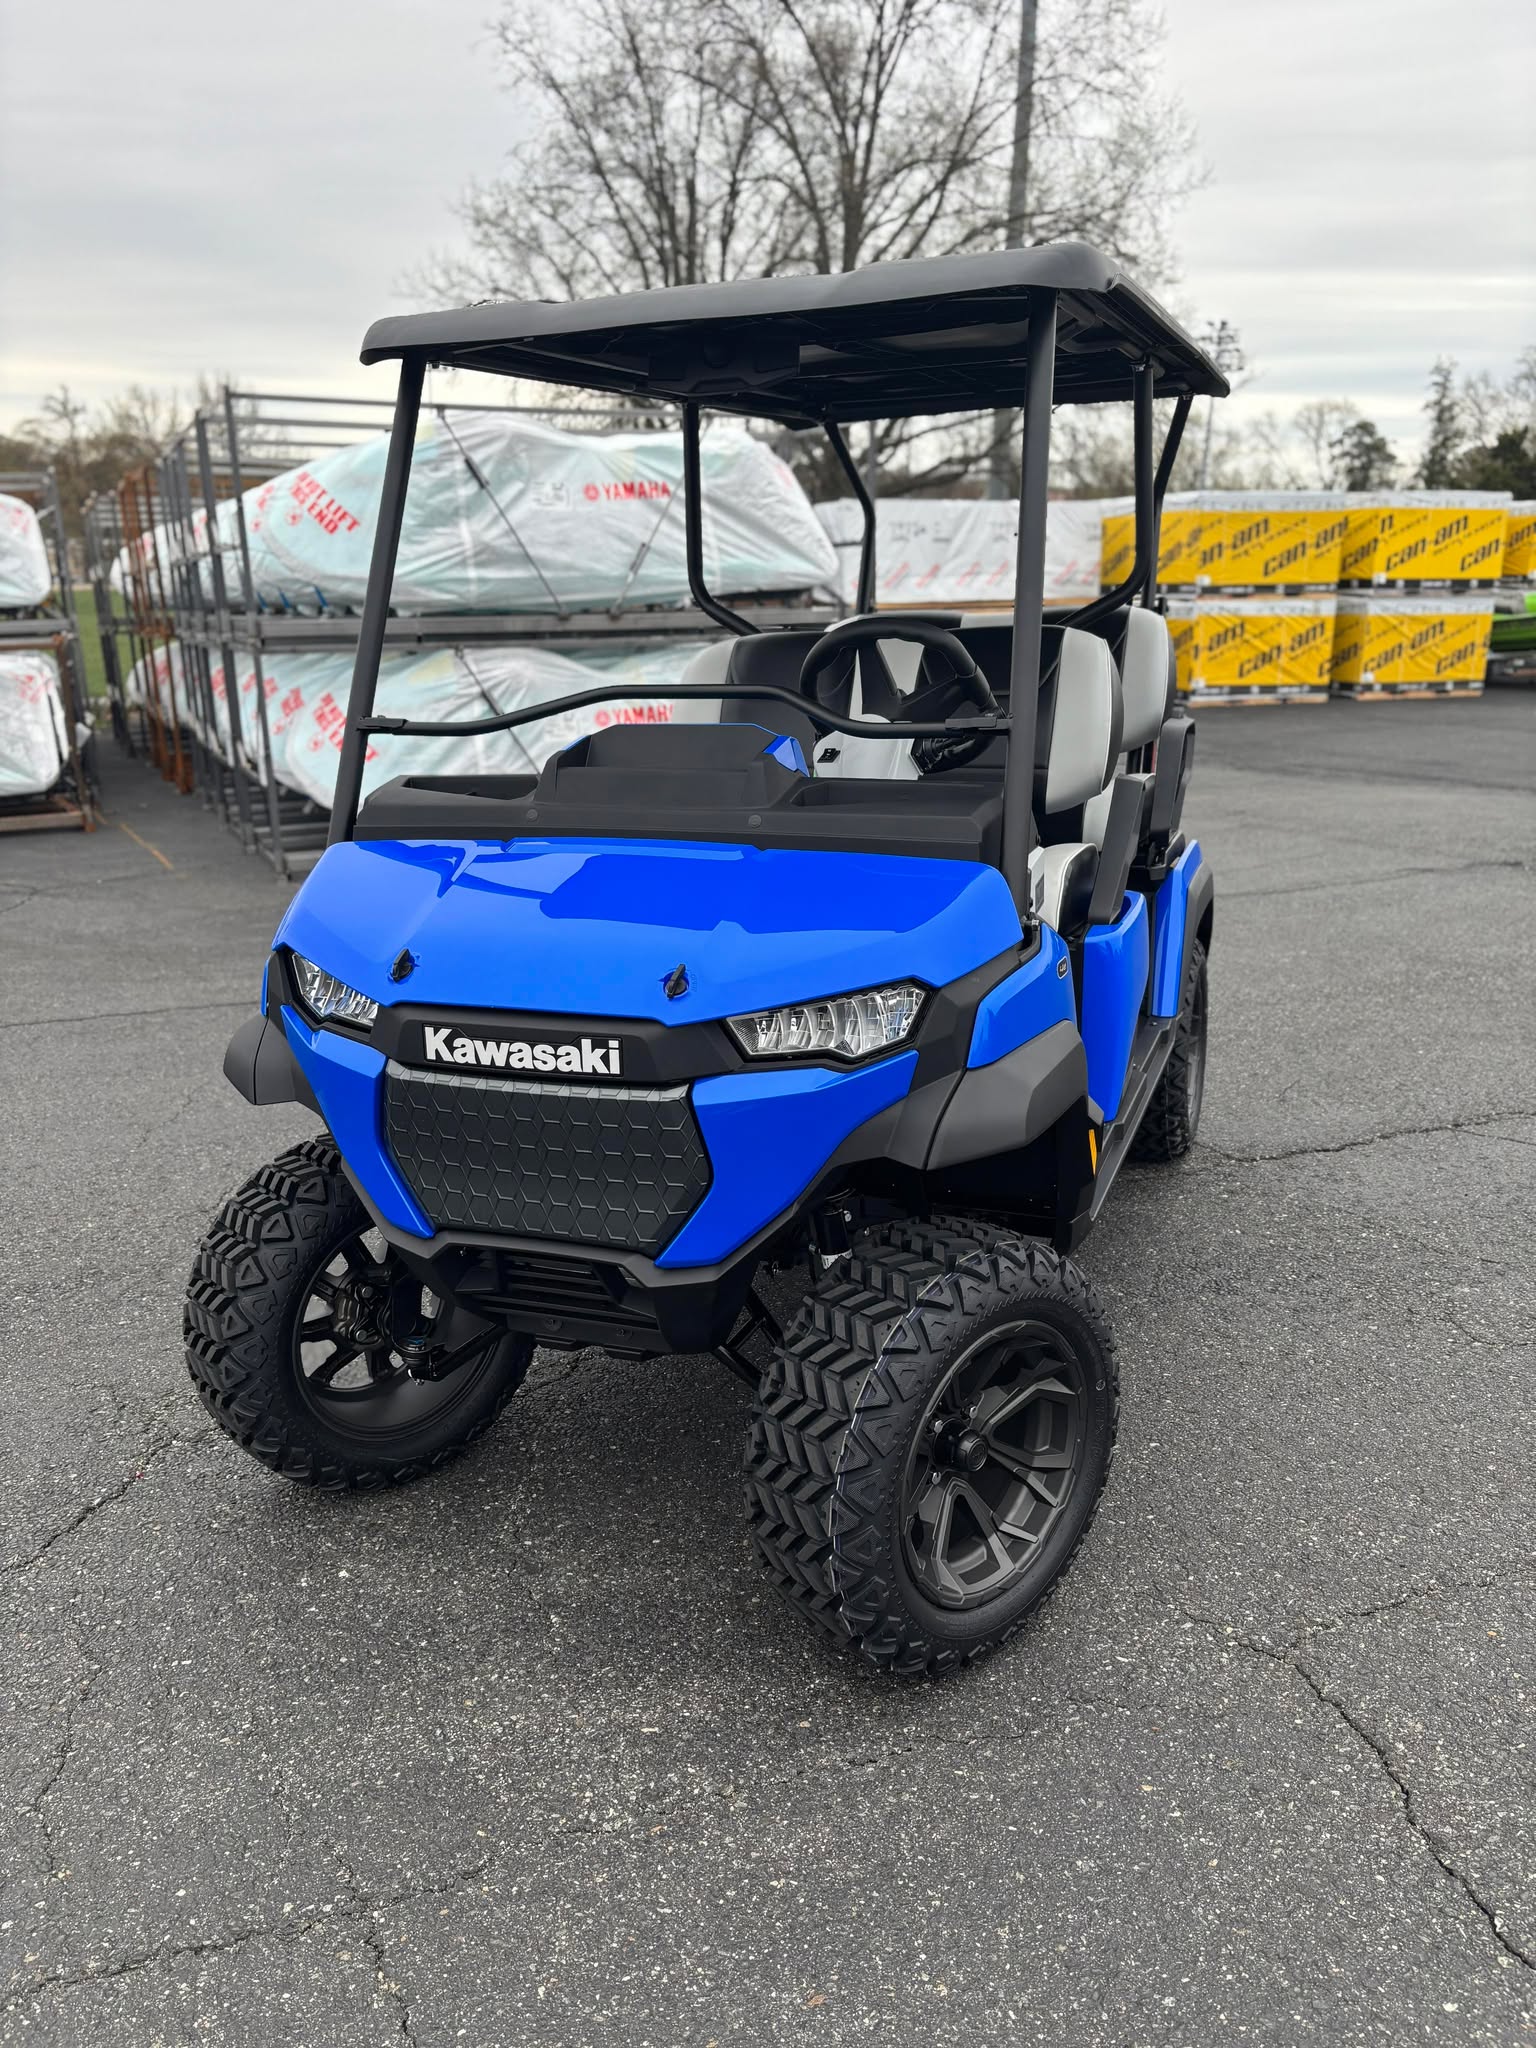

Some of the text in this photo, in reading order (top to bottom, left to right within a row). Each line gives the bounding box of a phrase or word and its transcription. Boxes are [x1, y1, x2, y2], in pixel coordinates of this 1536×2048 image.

[601, 481, 671, 500] YAMAHA
[307, 502, 339, 535] END
[325, 498, 361, 532] LIFT
[612, 704, 674, 724] YAMAH
[424, 1026, 621, 1075] Kawasaki
